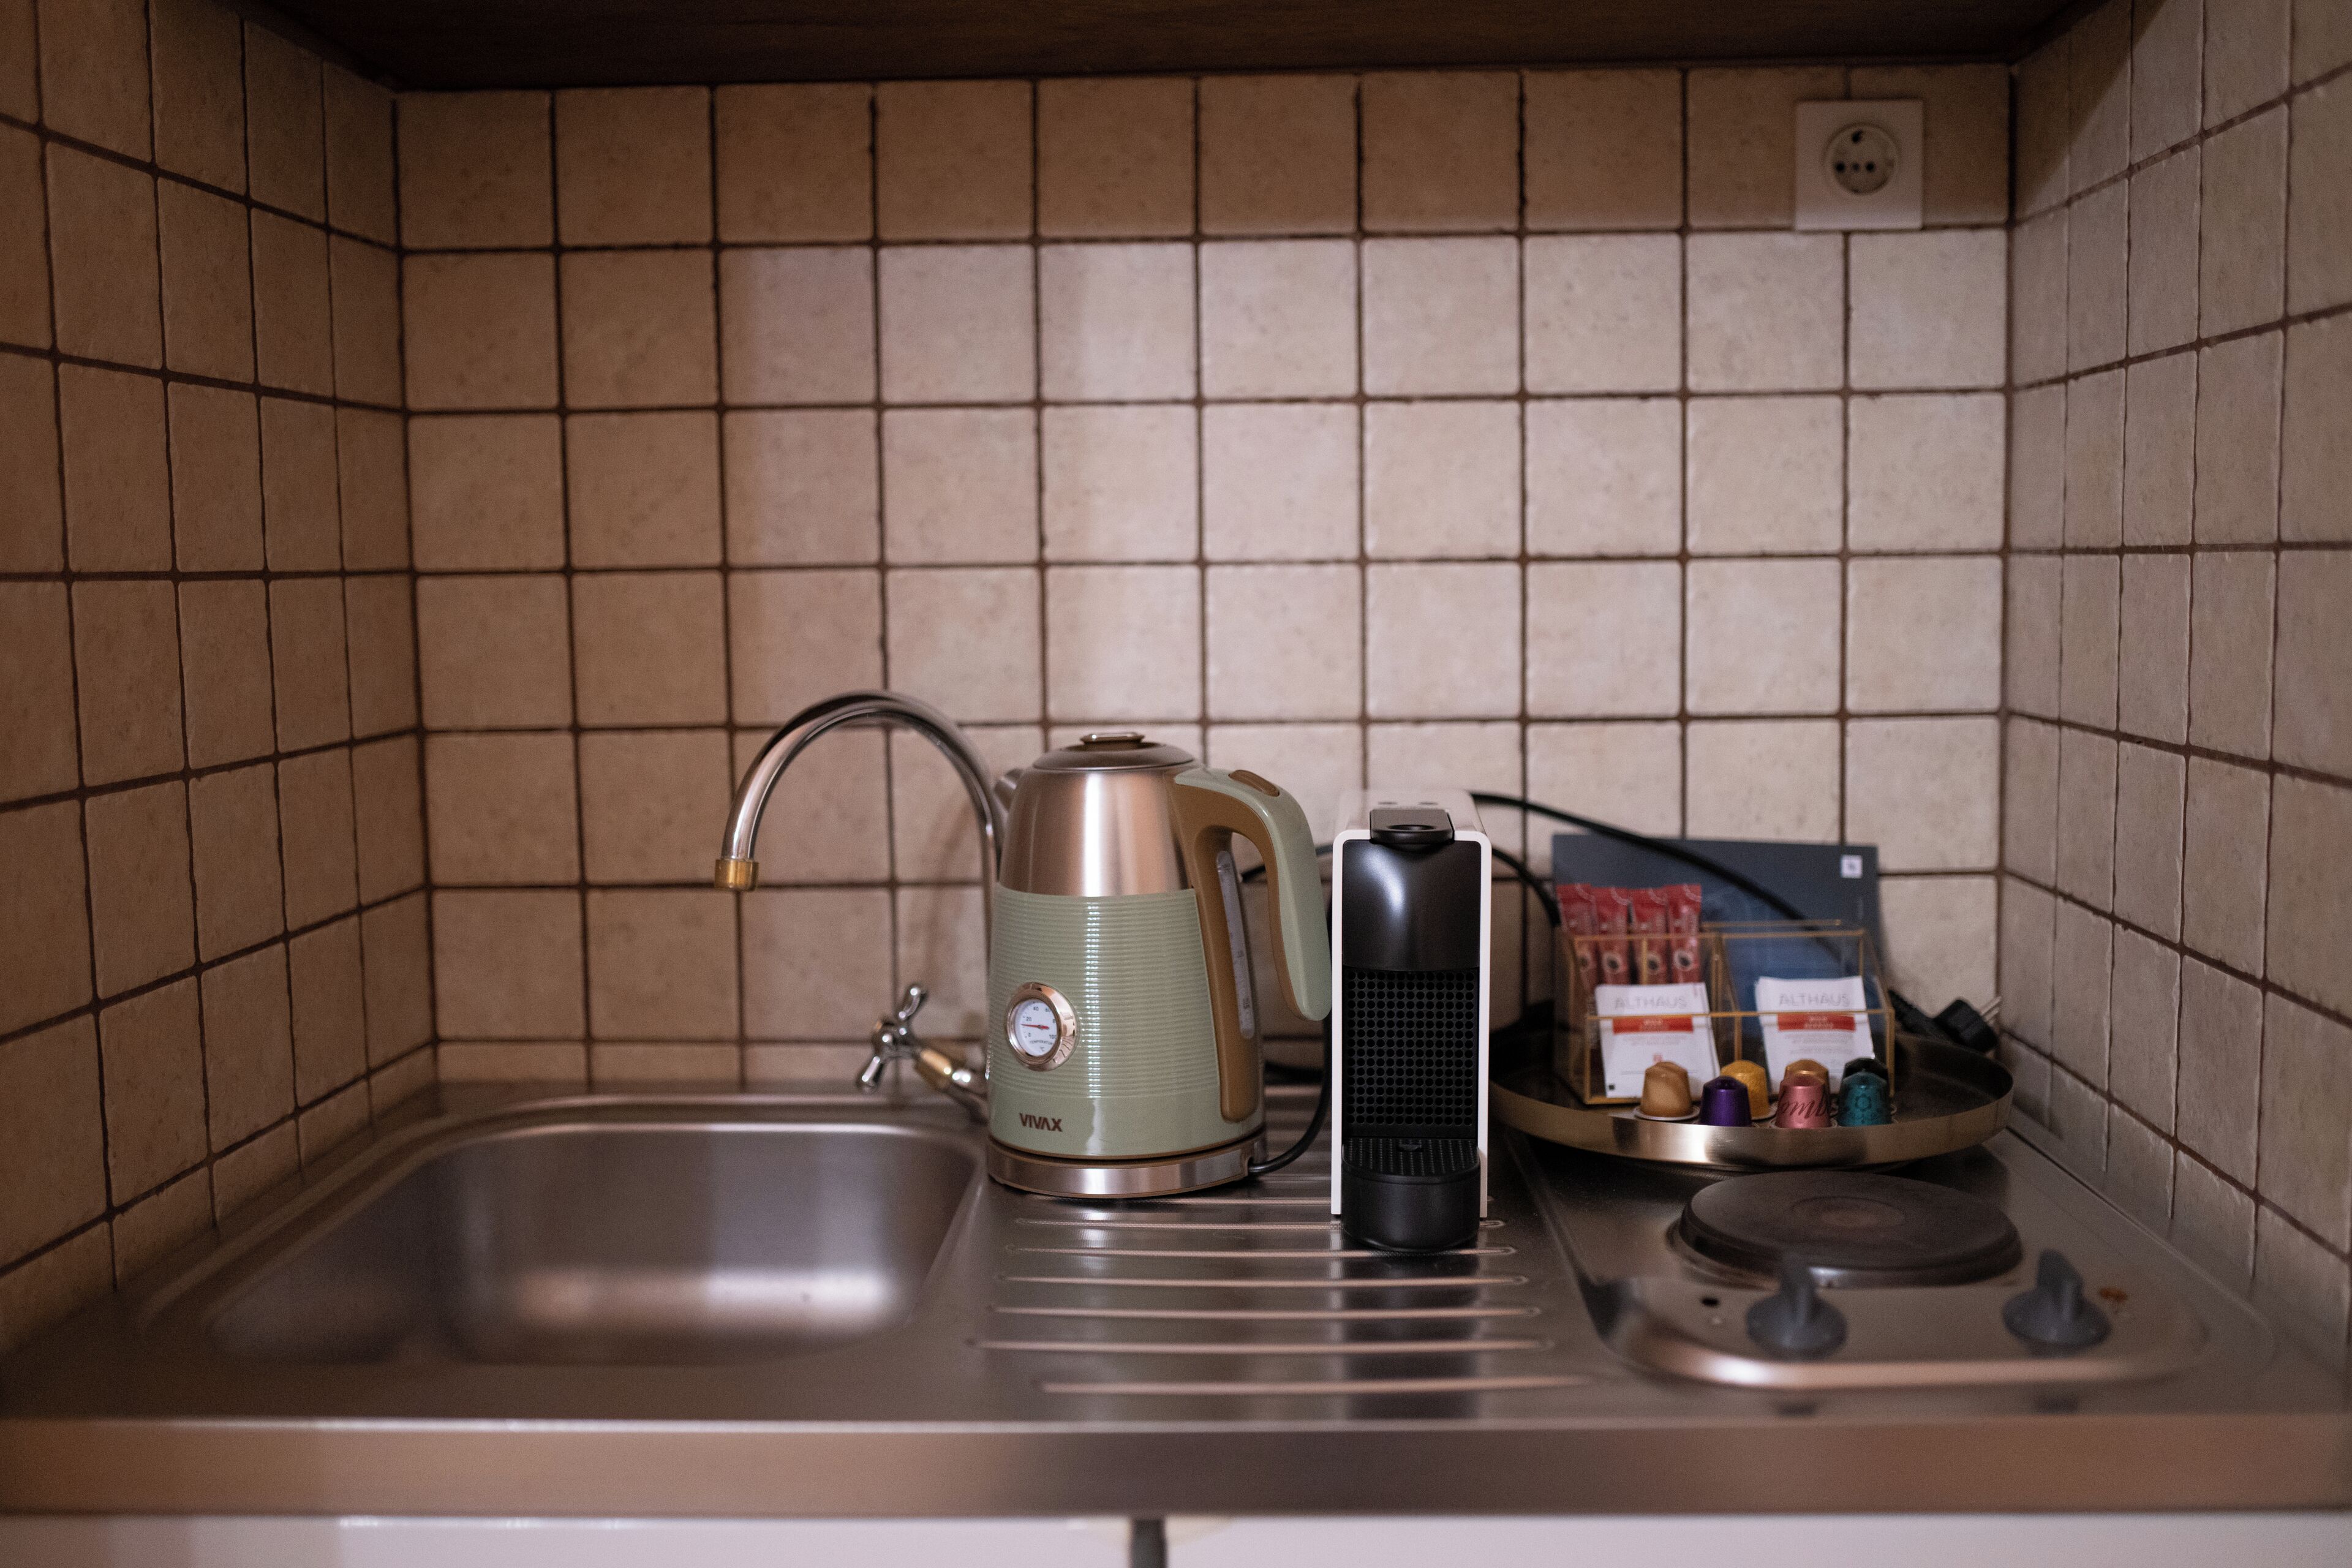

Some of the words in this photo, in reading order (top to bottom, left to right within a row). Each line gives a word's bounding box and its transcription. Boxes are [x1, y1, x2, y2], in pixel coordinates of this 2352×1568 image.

[1615, 996, 1687, 1009] ALTHAUS
[1779, 993, 1850, 1006] ALTHAUS
[1019, 1113, 1063, 1132] VIVAX
